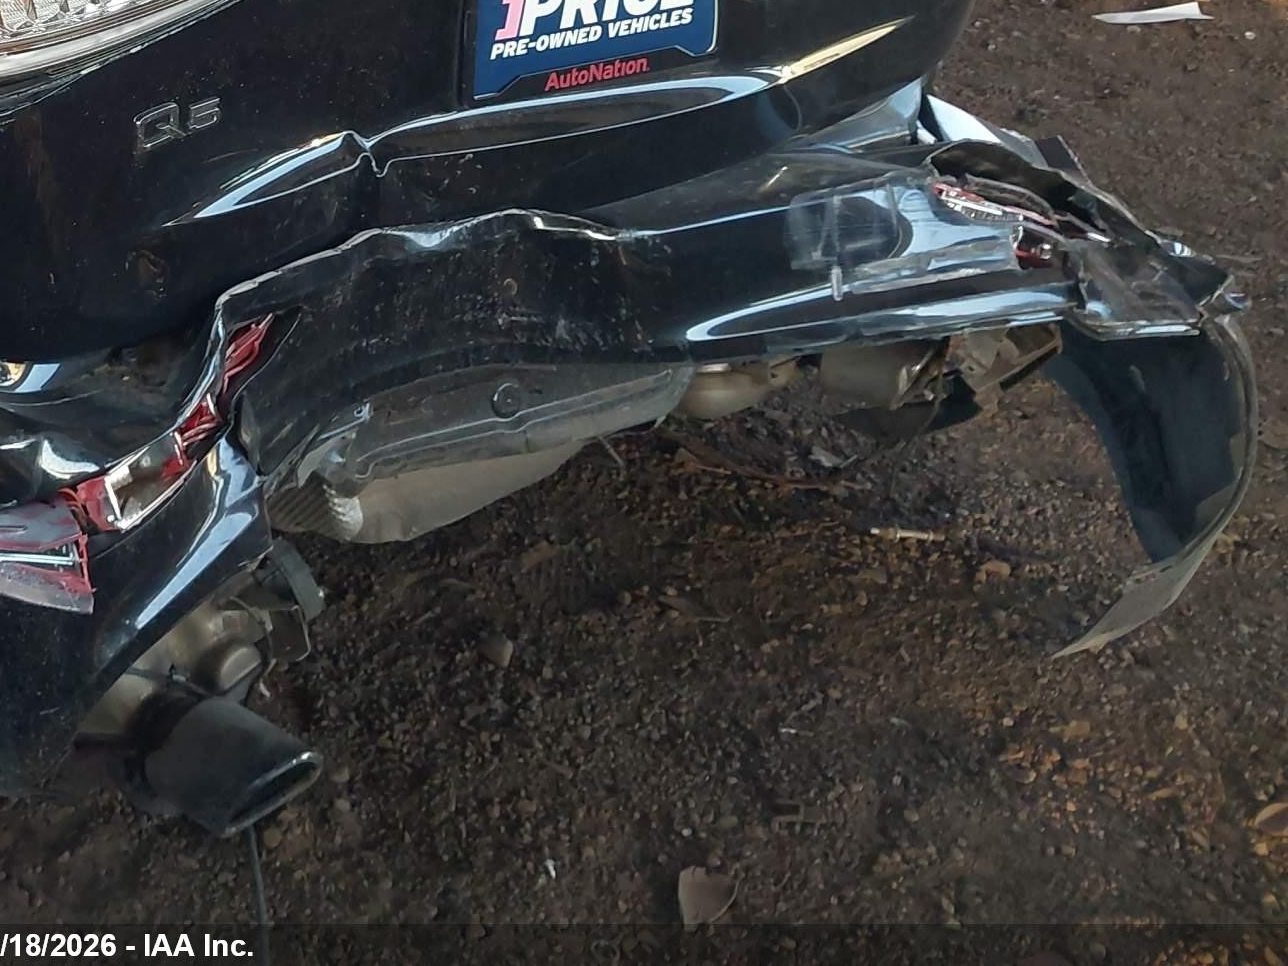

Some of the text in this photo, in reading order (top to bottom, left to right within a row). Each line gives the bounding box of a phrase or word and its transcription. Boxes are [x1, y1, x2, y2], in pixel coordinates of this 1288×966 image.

[490, 7, 693, 61] PRE-OWNED VEHICLES
[133, 96, 221, 153] Q5
